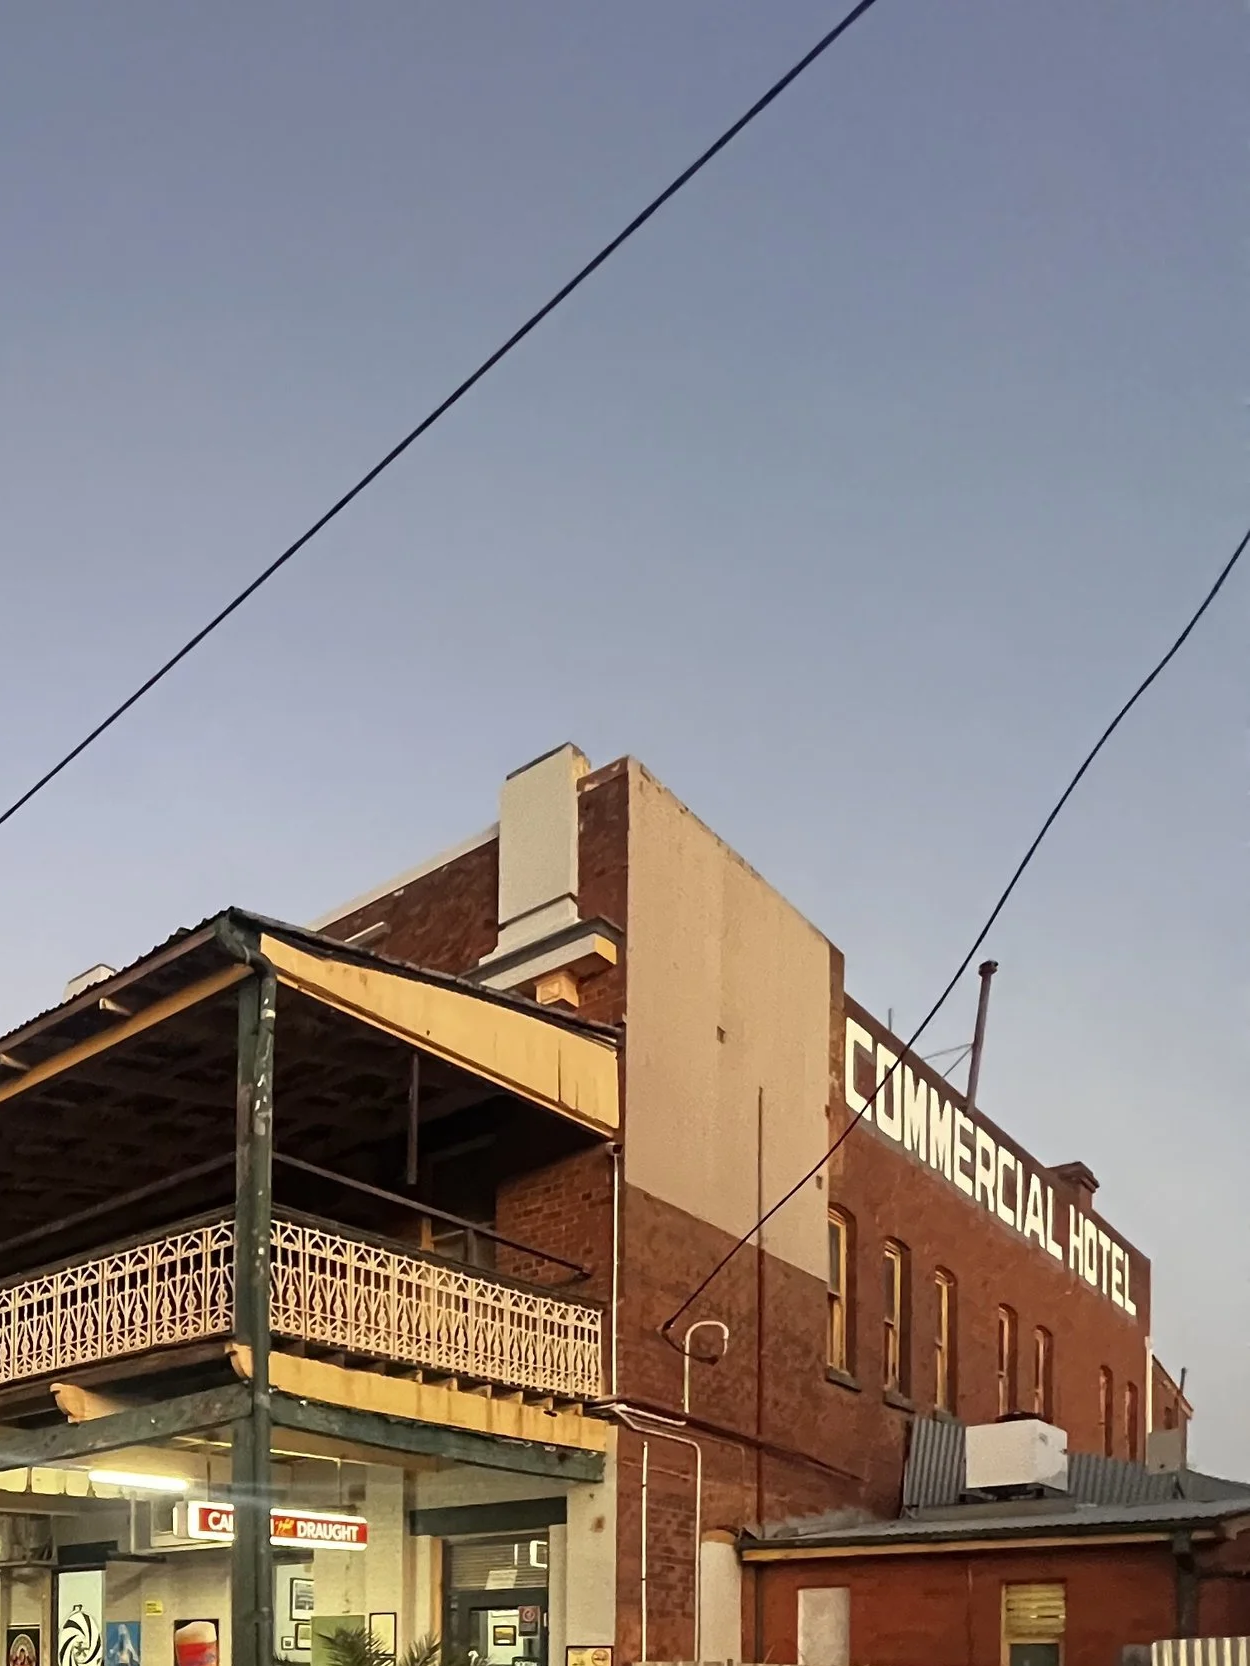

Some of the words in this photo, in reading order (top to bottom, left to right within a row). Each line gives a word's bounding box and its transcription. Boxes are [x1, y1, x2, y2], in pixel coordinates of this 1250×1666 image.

[845, 1016, 1063, 1261] COMMERCIAL
[1068, 1204, 1137, 1316] HOTEL
[295, 1520, 359, 1542] DRAUGHT
